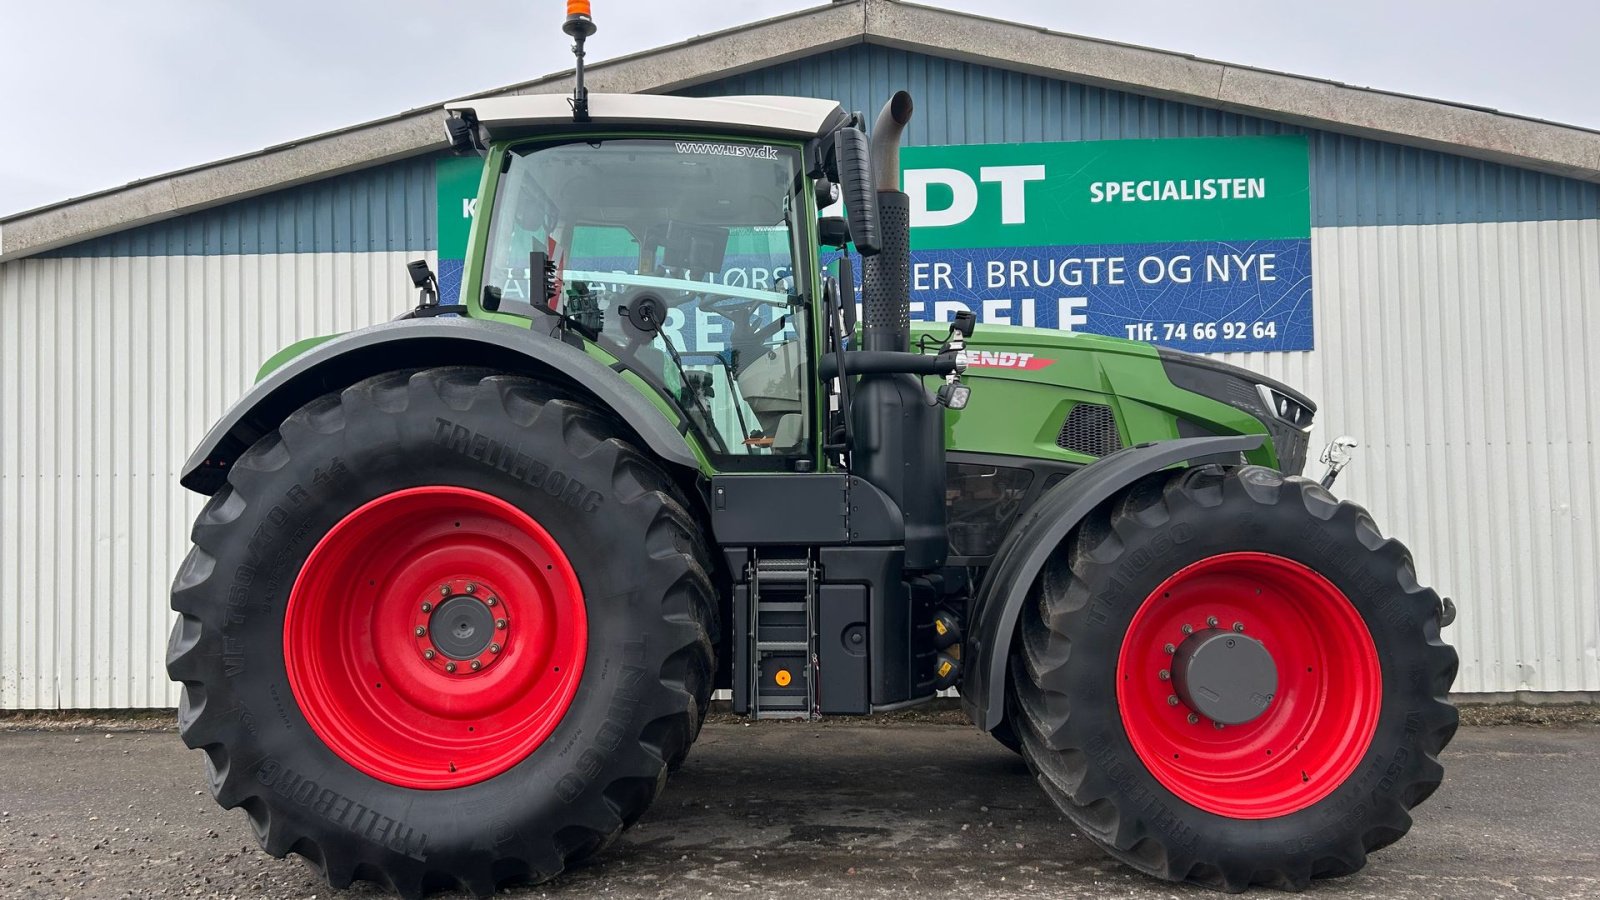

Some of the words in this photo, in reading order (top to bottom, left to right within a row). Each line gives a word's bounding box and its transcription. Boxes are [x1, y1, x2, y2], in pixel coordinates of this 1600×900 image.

[675, 142, 778, 160] www.usv.dk
[1090, 177, 1265, 203] SPECIALISTEN
[966, 261, 973, 289] I
[987, 257, 1125, 289] BRUGTE
[1138, 255, 1192, 284] OG
[1206, 253, 1276, 282] NYE
[1125, 323, 1158, 341] Tlf.
[1163, 323, 1187, 341] 74
[1193, 322, 1217, 340] 66
[1222, 322, 1247, 339] 92
[1252, 321, 1277, 339] 64
[965, 350, 1034, 368] ENDT
[433, 416, 604, 513] TRELLEBORG
[1085, 521, 1195, 626] TM1060
[256, 758, 428, 864] TRELLEBORG
